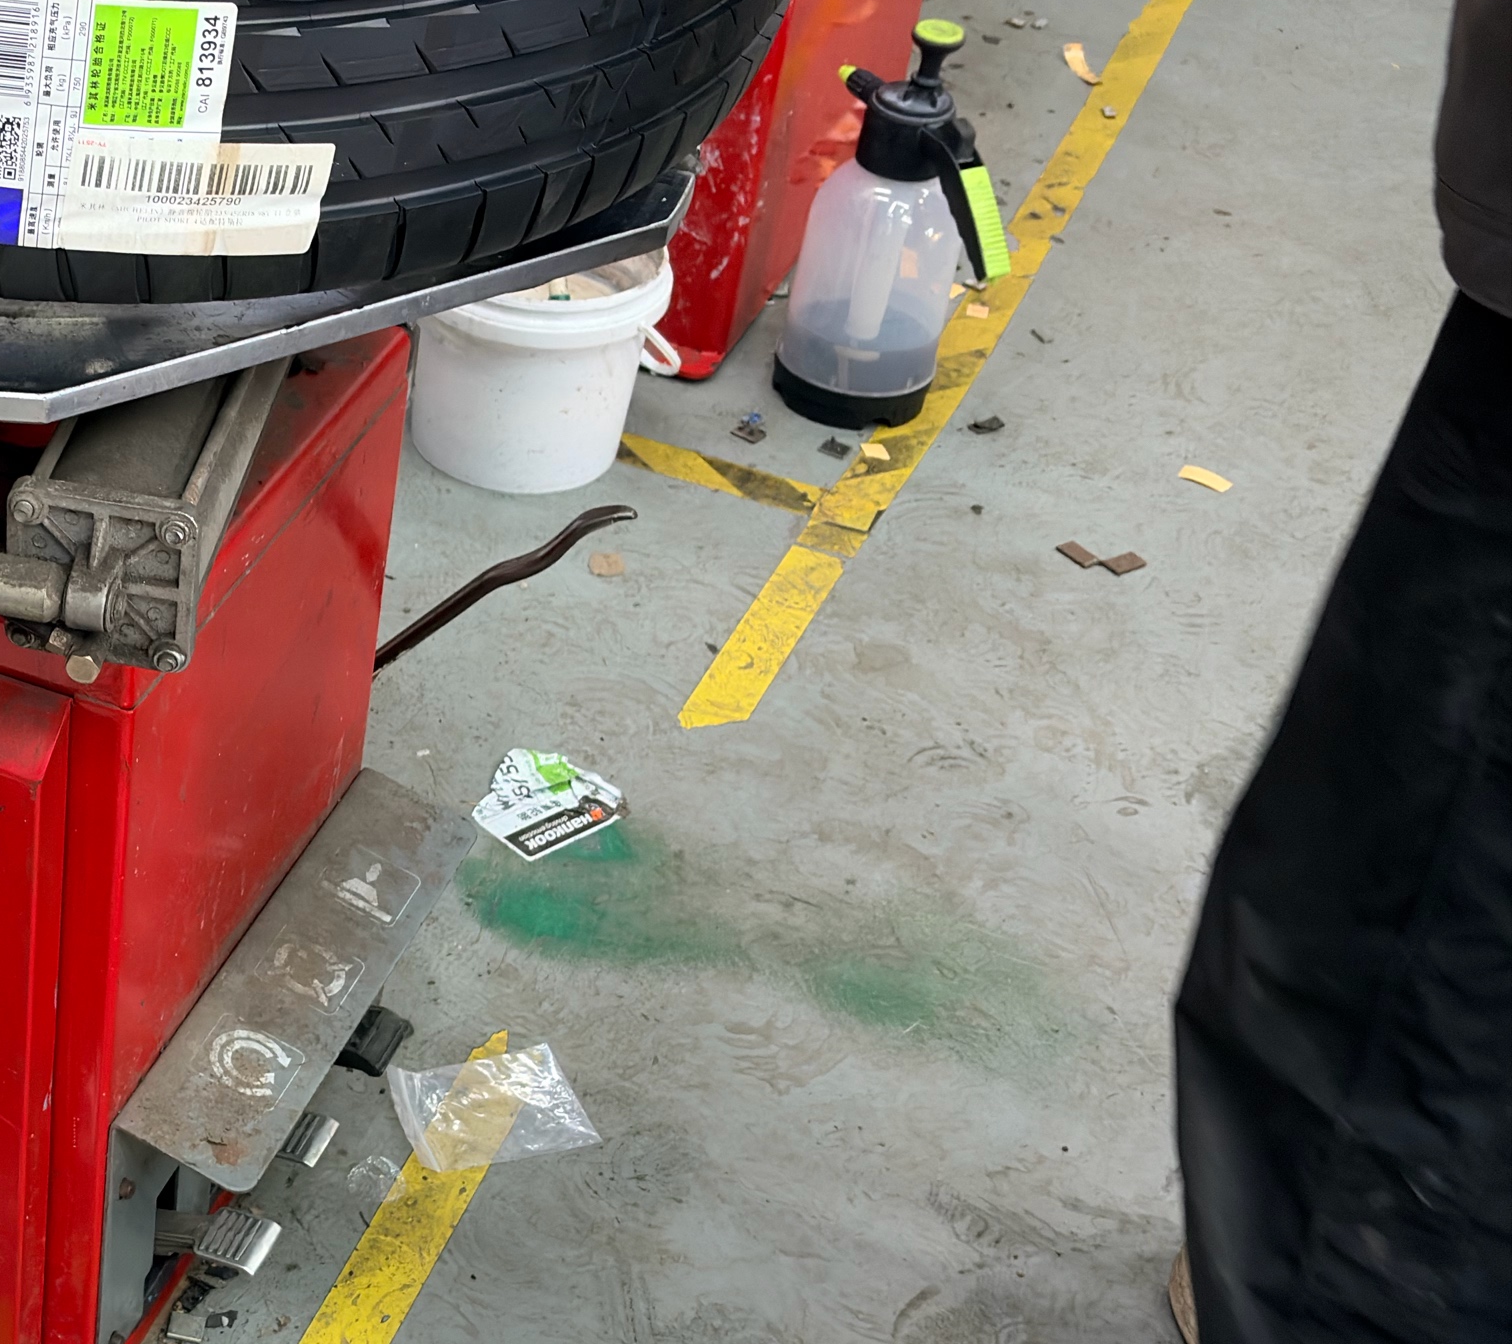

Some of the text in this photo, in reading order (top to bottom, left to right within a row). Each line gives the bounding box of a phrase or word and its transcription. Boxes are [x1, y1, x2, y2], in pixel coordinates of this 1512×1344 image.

[78, 21, 88, 37] 290
[88, 22, 106, 111] 米其林轮胎合格证
[196, 15, 221, 113] CAI 813934
[72, 77, 82, 91] 750
[145, 195, 242, 206] 100023425790
